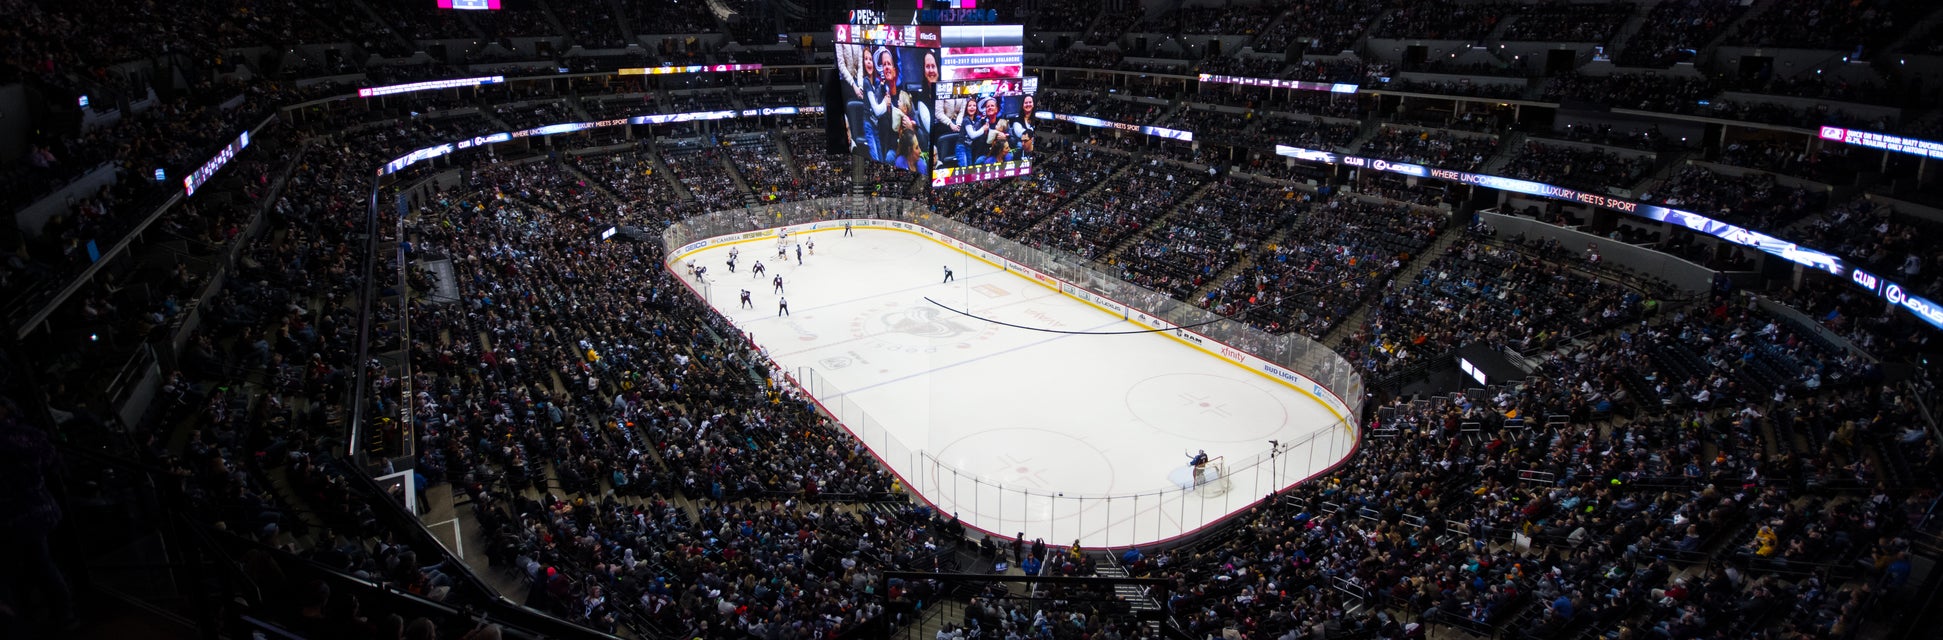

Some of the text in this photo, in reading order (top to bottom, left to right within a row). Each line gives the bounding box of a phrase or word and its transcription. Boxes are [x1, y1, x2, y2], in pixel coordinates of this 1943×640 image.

[857, 10, 880, 24] PEPSI
[458, 140, 471, 149] CLUB
[1847, 130, 1863, 138] QUICK
[1902, 138, 1918, 146] MATT
[1863, 138, 1886, 148] TRAILING
[1344, 156, 1422, 174] CLUB LEXUS
[1431, 168, 1637, 212] WHERE UNCOMPROMISED LUXURY MEETS SPORT
[685, 240, 707, 252] GEICO
[1852, 269, 1943, 324] CLUB LEXUS
[1101, 300, 1121, 311] LEXUS
[1183, 333, 1202, 344] RAM
[1220, 346, 1246, 363] xfinity
[1264, 365, 1298, 383] BUD LIGHT
